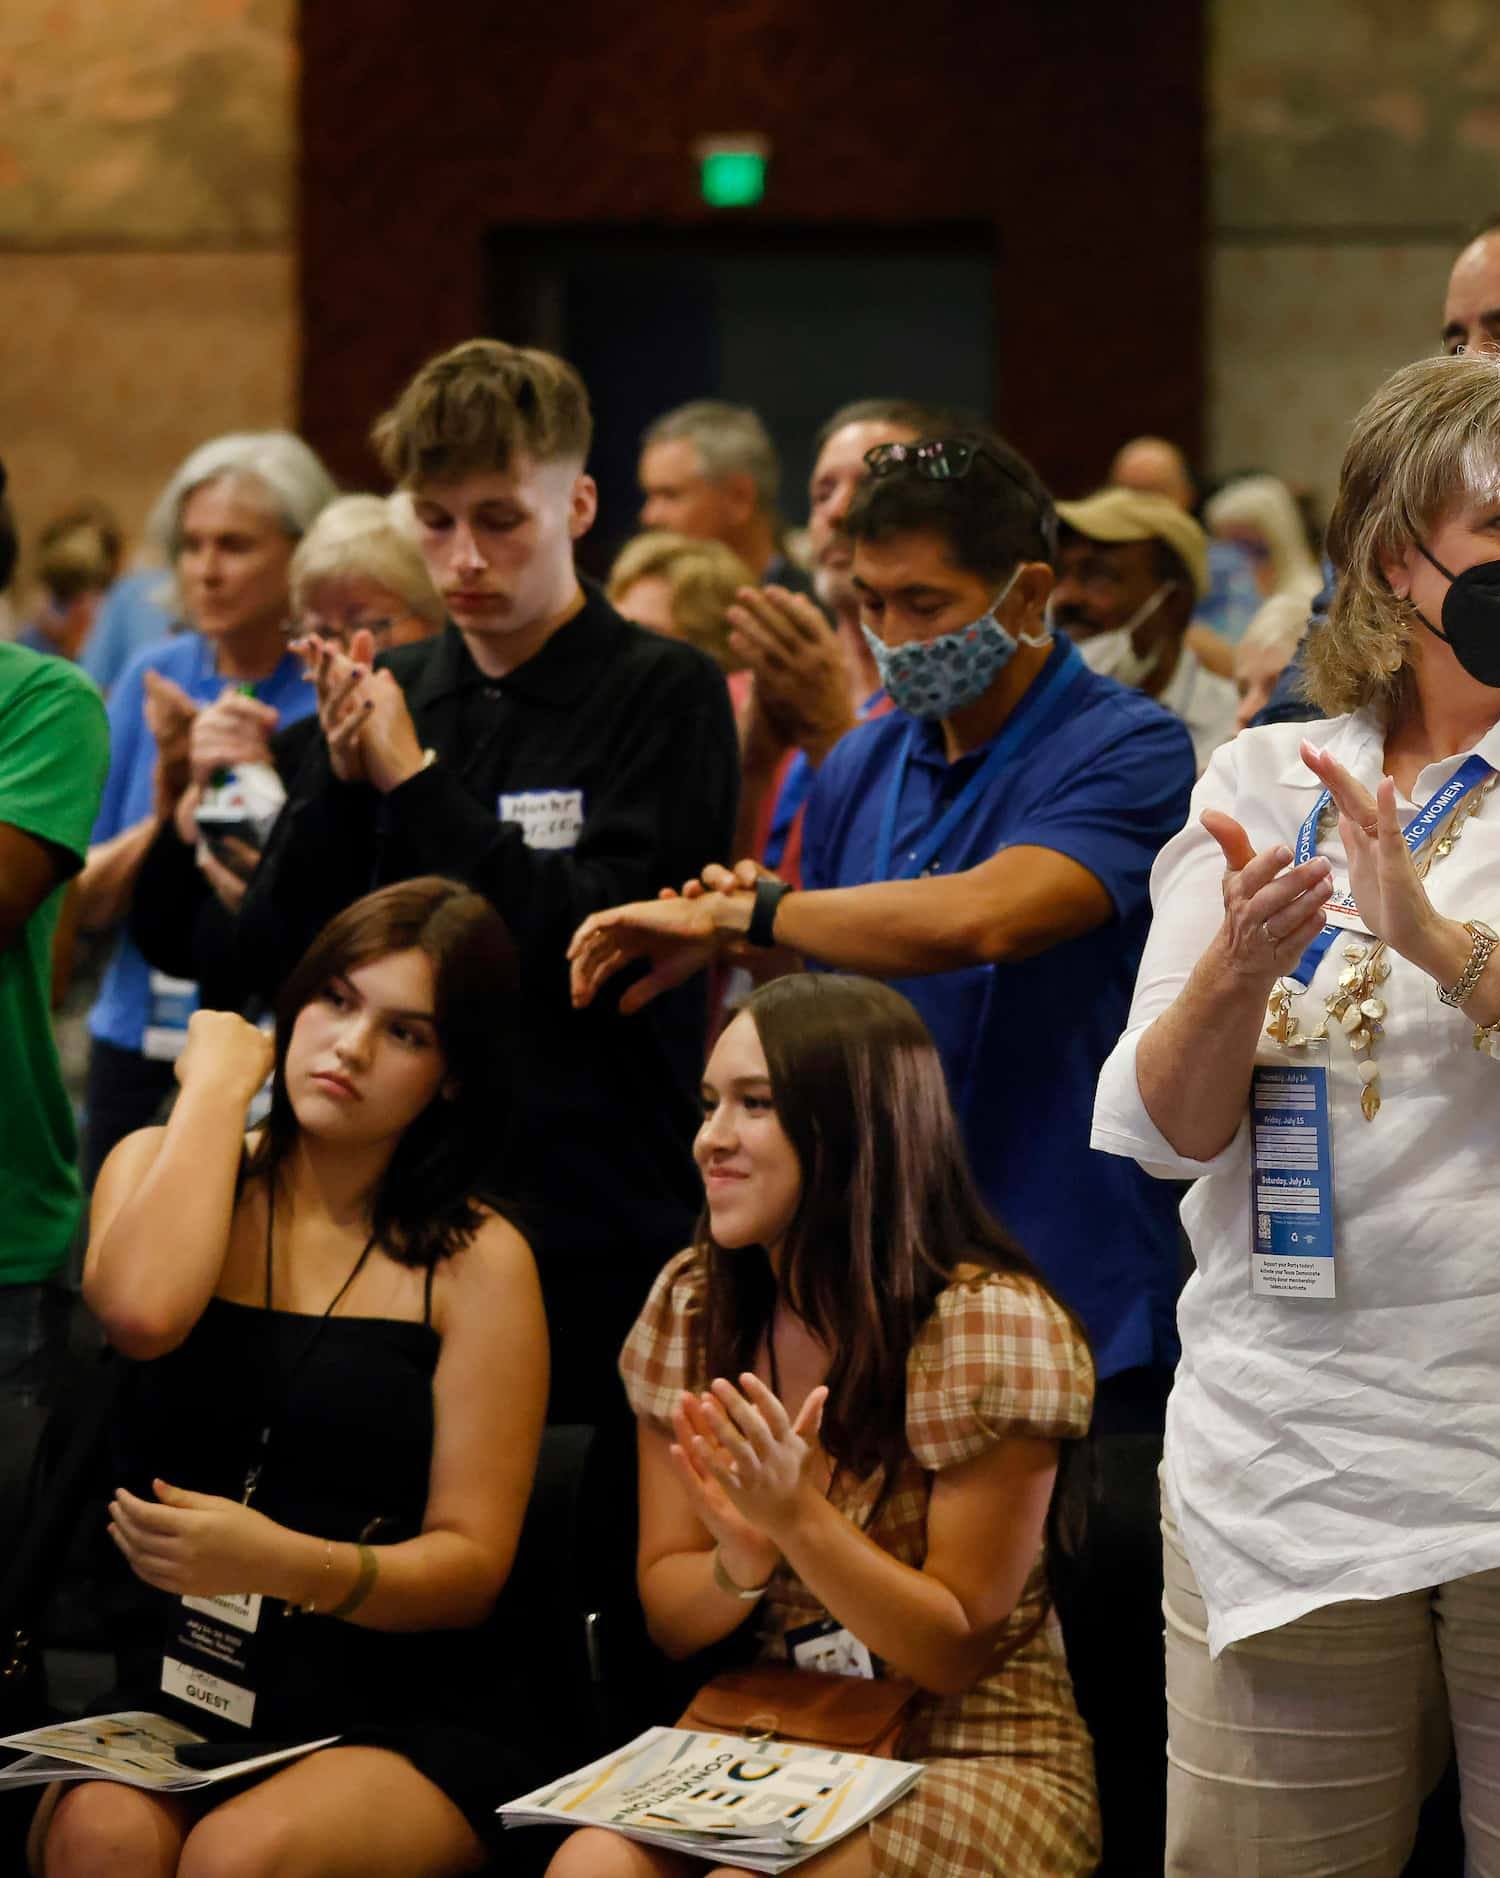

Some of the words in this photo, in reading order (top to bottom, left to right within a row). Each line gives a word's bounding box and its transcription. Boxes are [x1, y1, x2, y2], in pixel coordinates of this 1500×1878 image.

[1424, 781, 1464, 825] WOMEN
[1288, 1177, 1302, 1187] July
[186, 1684, 231, 1711] GUEST
[619, 1753, 734, 1814] CONVENTION
